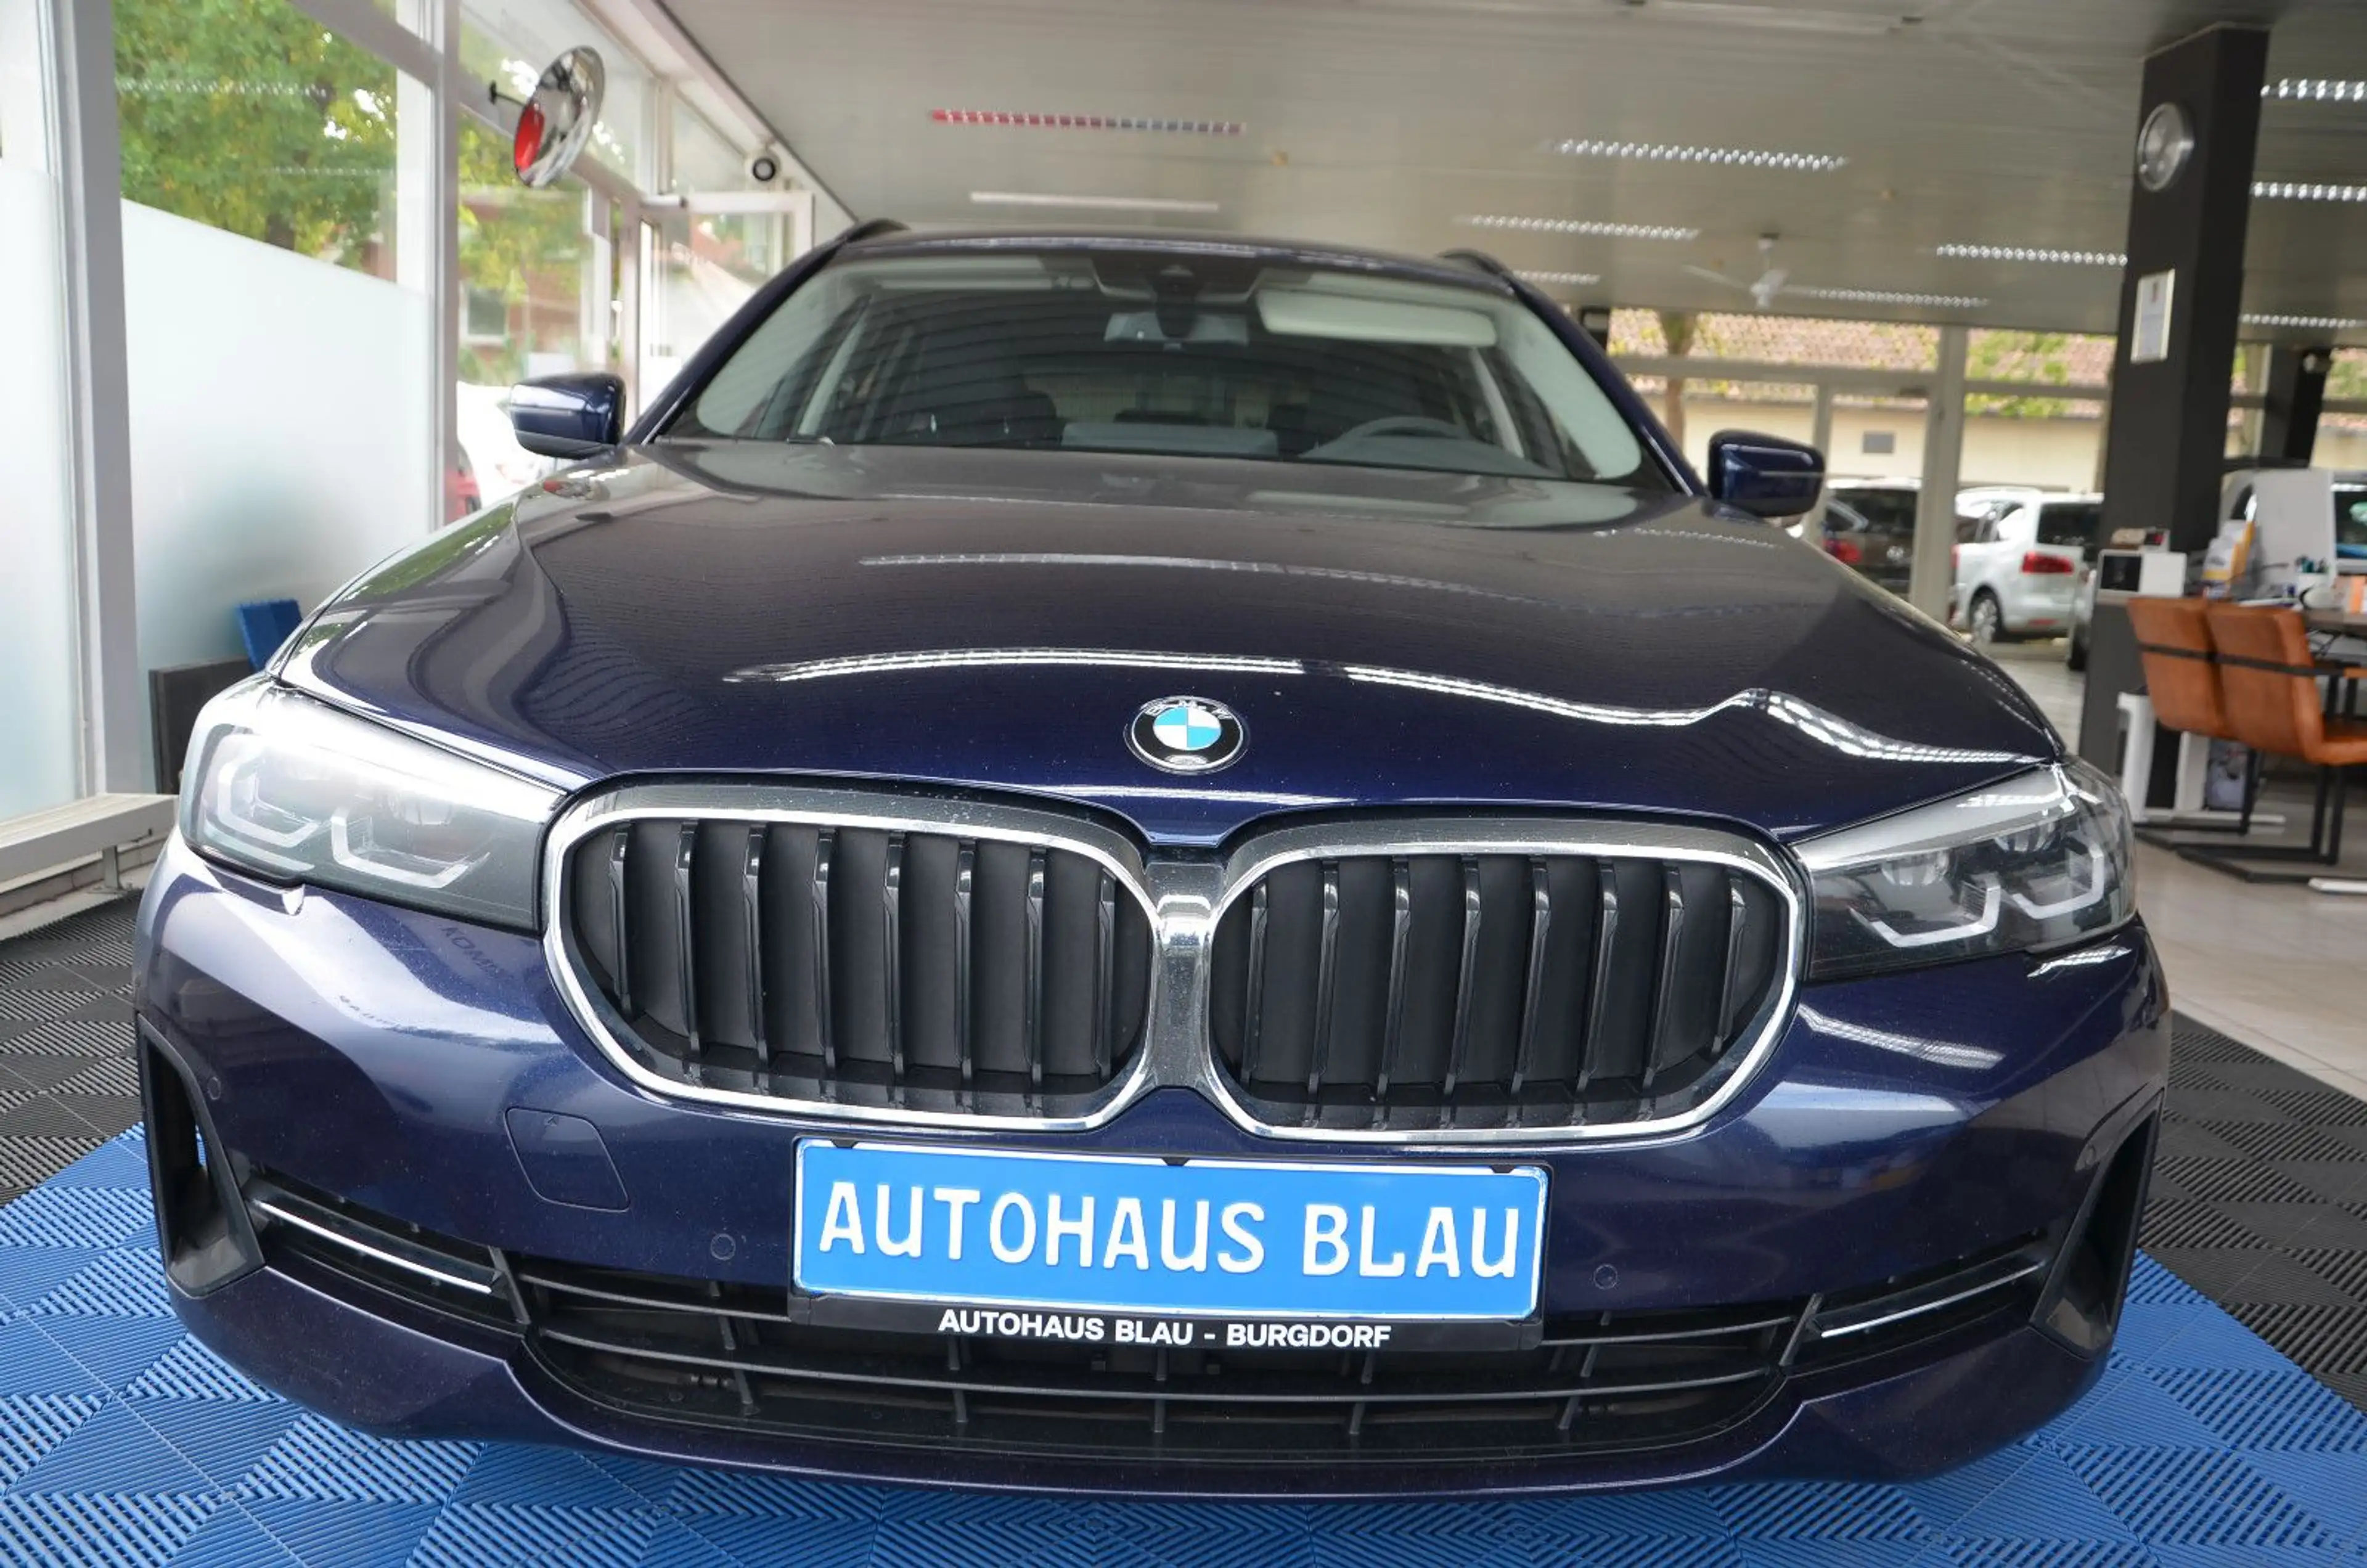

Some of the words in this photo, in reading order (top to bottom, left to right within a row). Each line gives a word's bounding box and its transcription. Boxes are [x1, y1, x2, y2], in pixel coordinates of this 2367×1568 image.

[1143, 699, 1233, 720] BMW
[819, 1181, 1265, 1273] AUTOHAUS
[1302, 1203, 1519, 1278] BLAU
[938, 1309, 1105, 1341] AUTOHAUS
[1114, 1320, 1193, 1345] BLAU
[1226, 1323, 1392, 1348] BURGDORF
